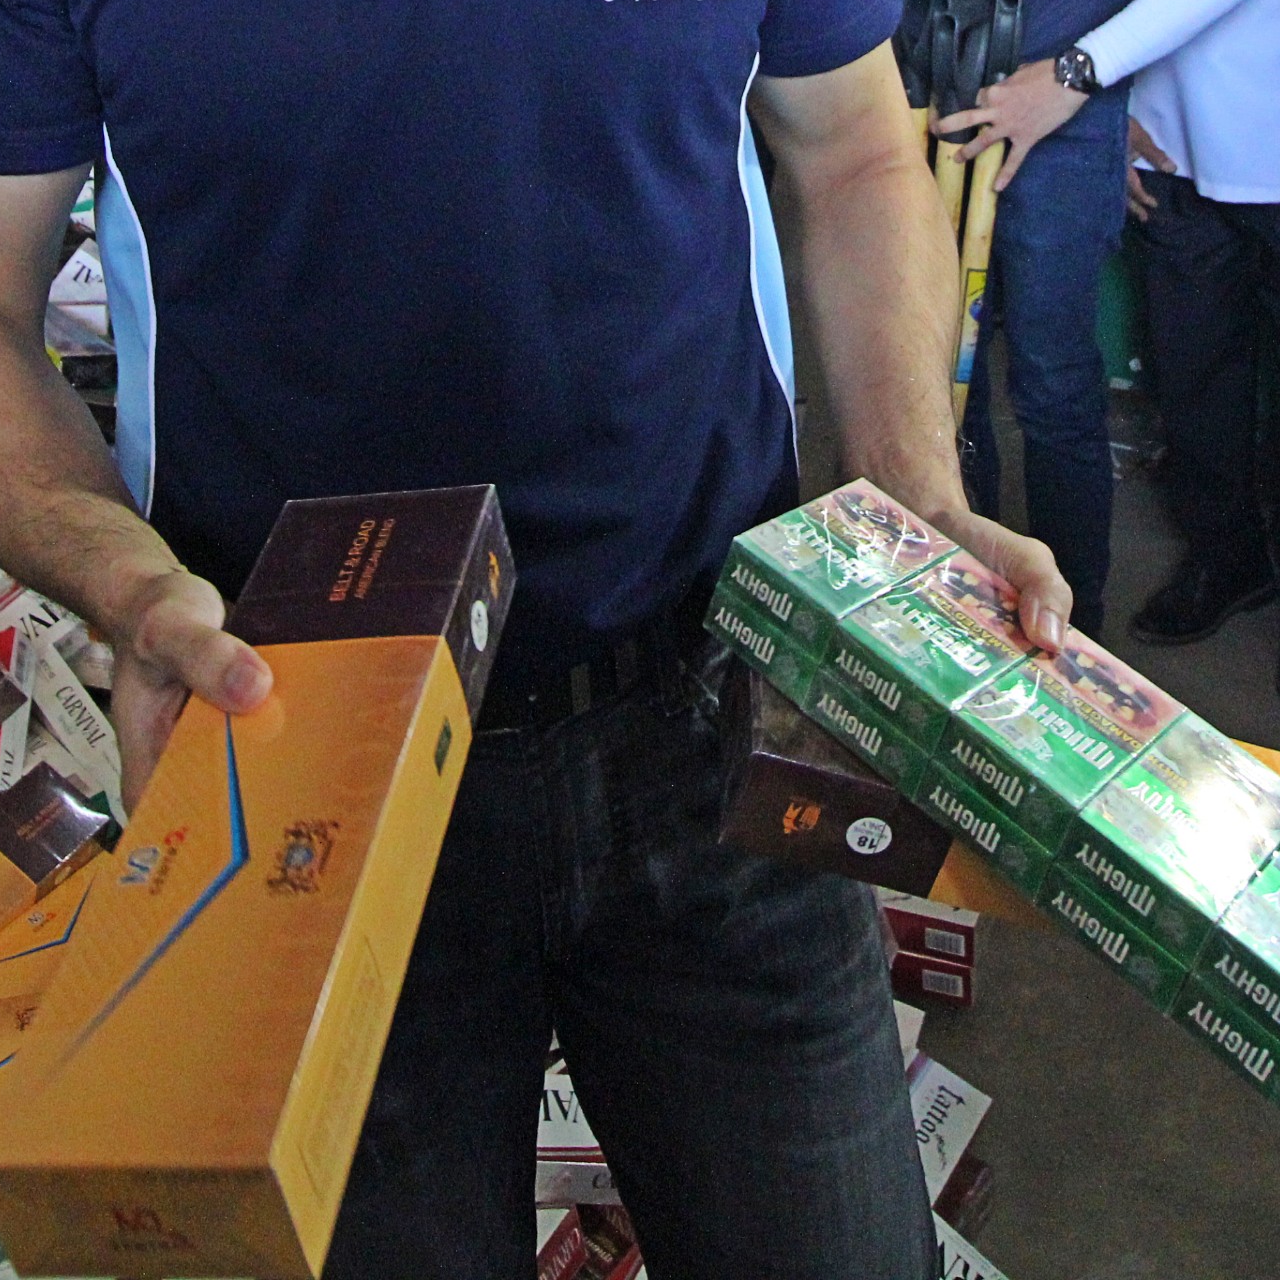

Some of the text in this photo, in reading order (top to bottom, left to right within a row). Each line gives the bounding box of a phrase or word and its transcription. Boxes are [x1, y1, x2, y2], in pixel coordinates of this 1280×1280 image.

[348, 519, 376, 560] ROAD
[730, 562, 795, 623] MIGHTY
[713, 605, 776, 666] MIGHTY
[834, 647, 903, 713] MIGHTY
[55, 685, 107, 749] CARNIVAL
[816, 691, 883, 757] MIGHTY
[1074, 698, 1144, 750] DAMAGED
[951, 738, 1025, 808] MIGHTY
[857, 835, 878, 850] 18
[928, 784, 1002, 854] MIGHTY
[1075, 842, 1157, 918] MIGHTY
[1051, 890, 1131, 966] MIGHTY
[1187, 1000, 1276, 1083] MIGHTY
[916, 1084, 966, 1145] tattoo
